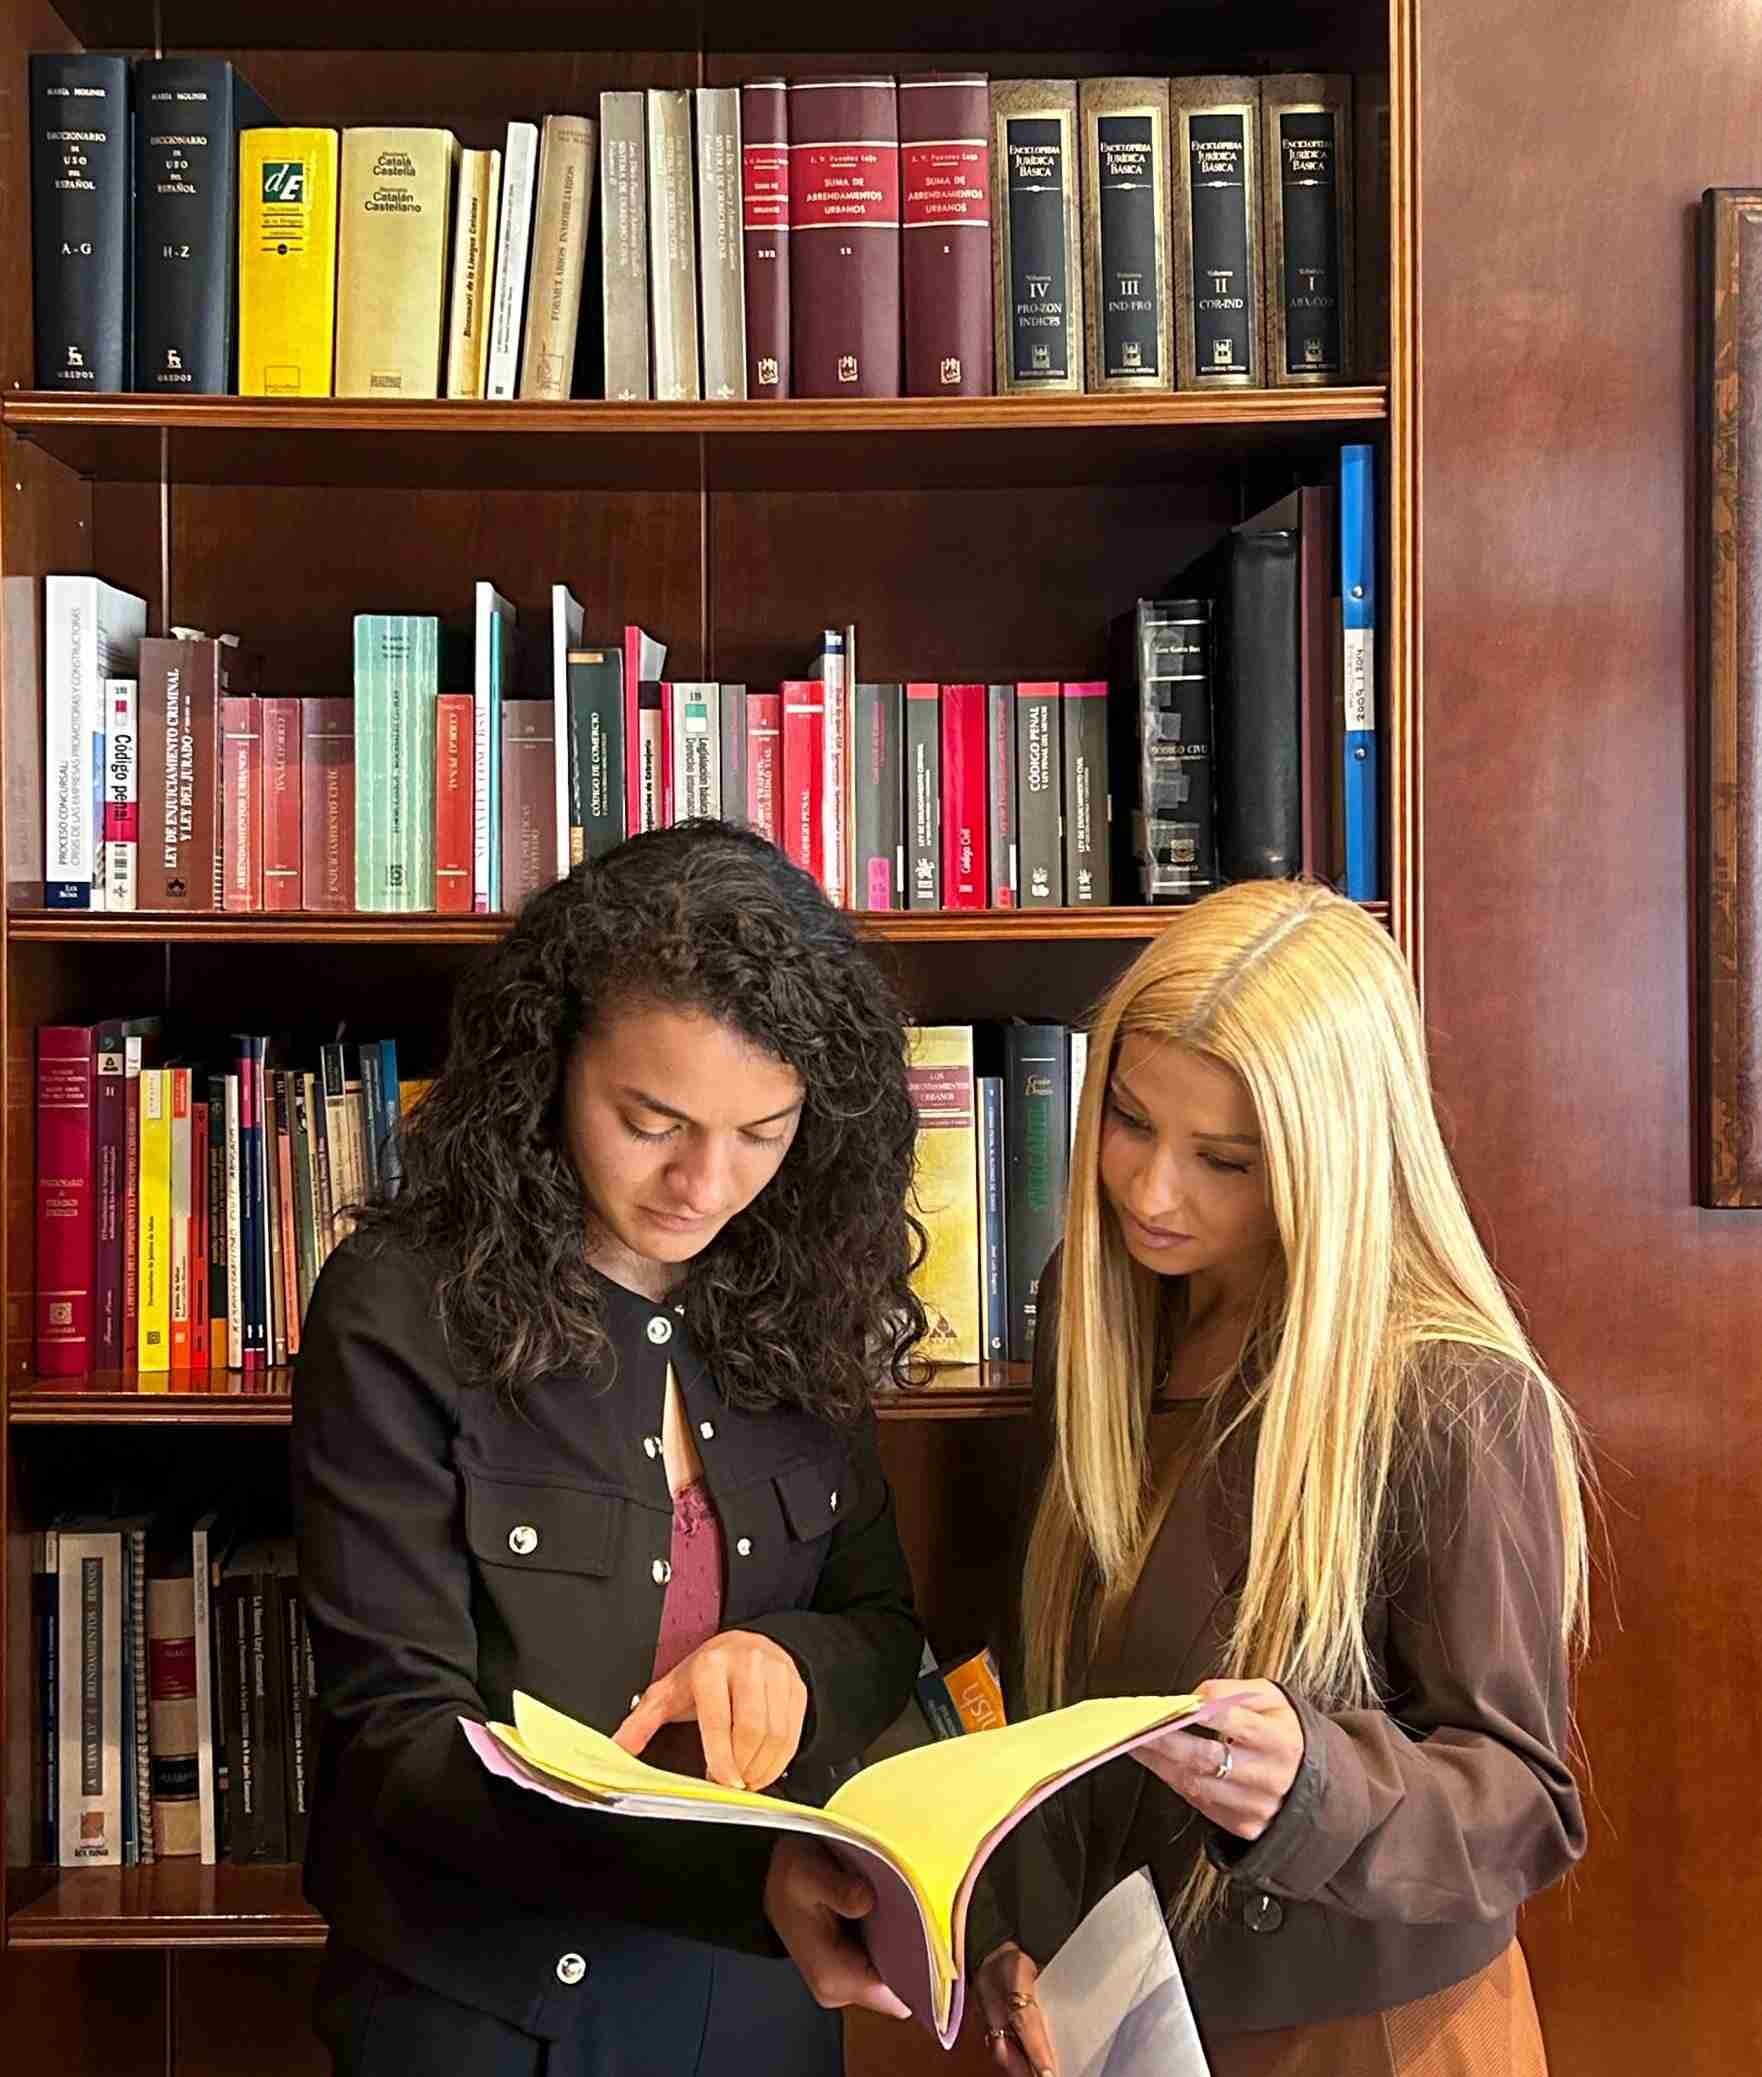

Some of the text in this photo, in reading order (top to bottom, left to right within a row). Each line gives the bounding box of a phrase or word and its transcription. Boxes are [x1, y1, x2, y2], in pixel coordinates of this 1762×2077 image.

[47, 130, 106, 142] DICCIONARIO
[151, 135, 208, 146] DICCIONARIO
[63, 155, 88, 166] USO
[165, 160, 188, 170] USO
[1201, 159, 1234, 173] BÁSICA
[1292, 158, 1325, 172] BÁSICA
[1019, 163, 1052, 177] BÁSICA
[1110, 161, 1143, 175] BÁSICA
[55, 177, 96, 190] ESPAÑOL
[157, 180, 197, 194] ESPAÑOL
[824, 177, 864, 187] SUMA DE
[925, 176, 966, 187] SUMA DE
[806, 190, 883, 201] ARRENDAMIENTOS
[908, 189, 983, 200] ARRENDAMIENTOS
[364, 201, 421, 212] Castellano
[824, 204, 866, 215] URBANOS
[925, 203, 967, 214] URBANOS
[1029, 283, 1049, 298] IV
[1120, 281, 1139, 296] III
[1214, 278, 1228, 293] II
[72, 607, 81, 687] CONSTRUCTORAS
[72, 693, 81, 757] PROMOTORAS
[1028, 706, 1041, 792] CÓDIGO PENAL
[111, 734, 132, 780] Código
[165, 668, 179, 868] LEY DE ENJUICIAMIENTO CRIMINAL
[590, 712, 601, 817] CÓDIGO DE COMERCIO
[181, 735, 193, 842] Y LEY DEL JURADO
[72, 823, 81, 838] DE
[59, 822, 69, 865] PROCESO
[960, 847, 973, 874] Código
